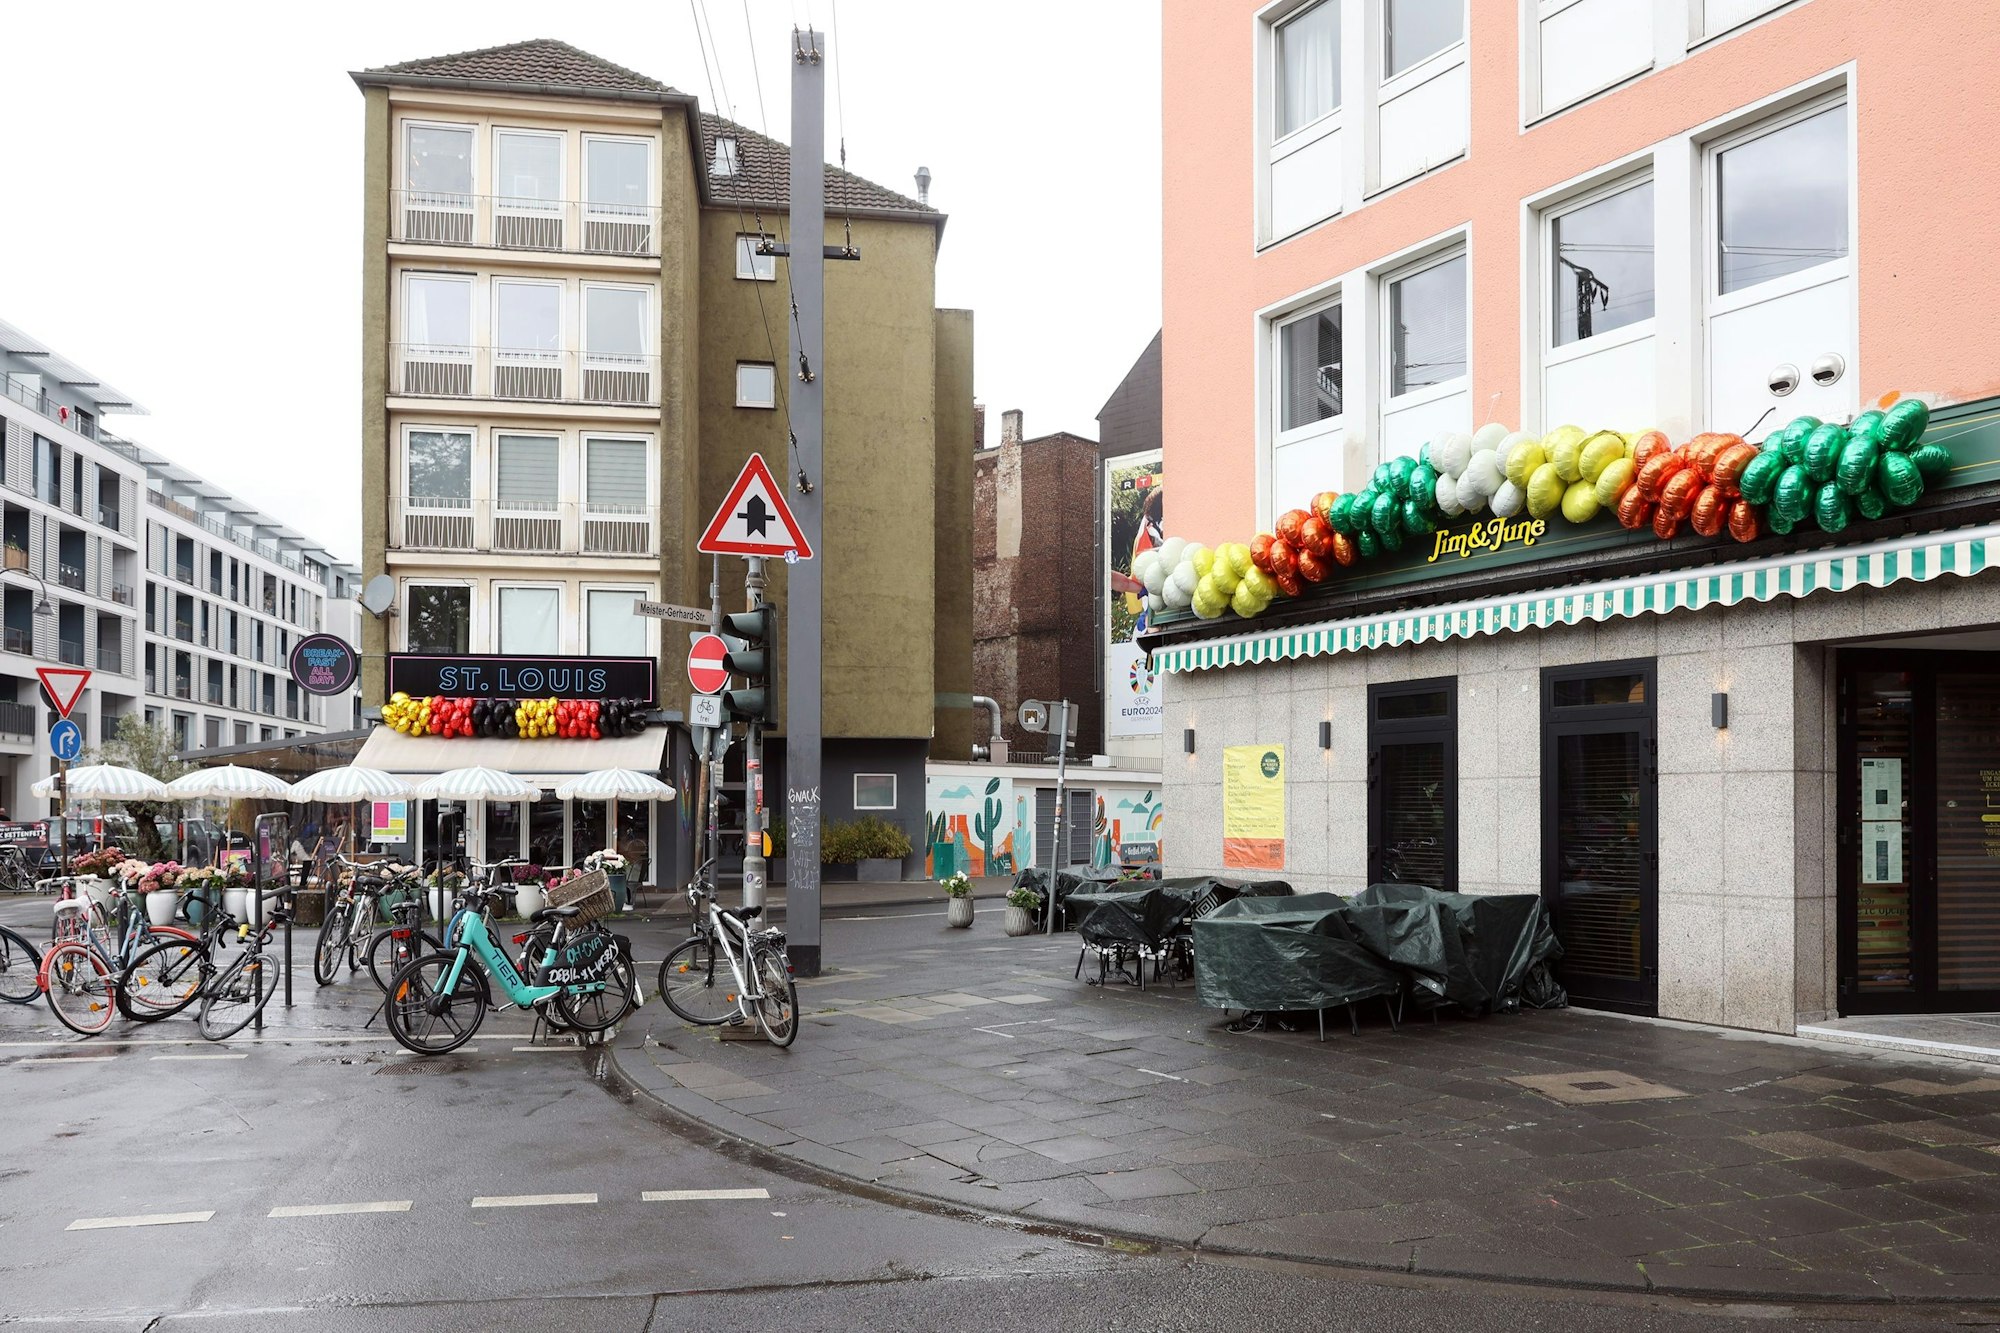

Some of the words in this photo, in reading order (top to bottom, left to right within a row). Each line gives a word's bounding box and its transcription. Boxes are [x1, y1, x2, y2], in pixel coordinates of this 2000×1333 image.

[640, 602, 707, 622] Meister-Gerhard-Str.
[1354, 627, 1405, 642] CAFE
[1429, 619, 1468, 632] BAR
[1493, 600, 1613, 624] KITCHEN
[303, 648, 346, 658] BREAK-
[307, 657, 337, 667] FAST
[310, 666, 333, 675] ALL
[308, 675, 335, 684] DAY!
[439, 667, 489, 690] ST.
[499, 668, 607, 692] LOUIS
[492, 949, 518, 989] TIER
